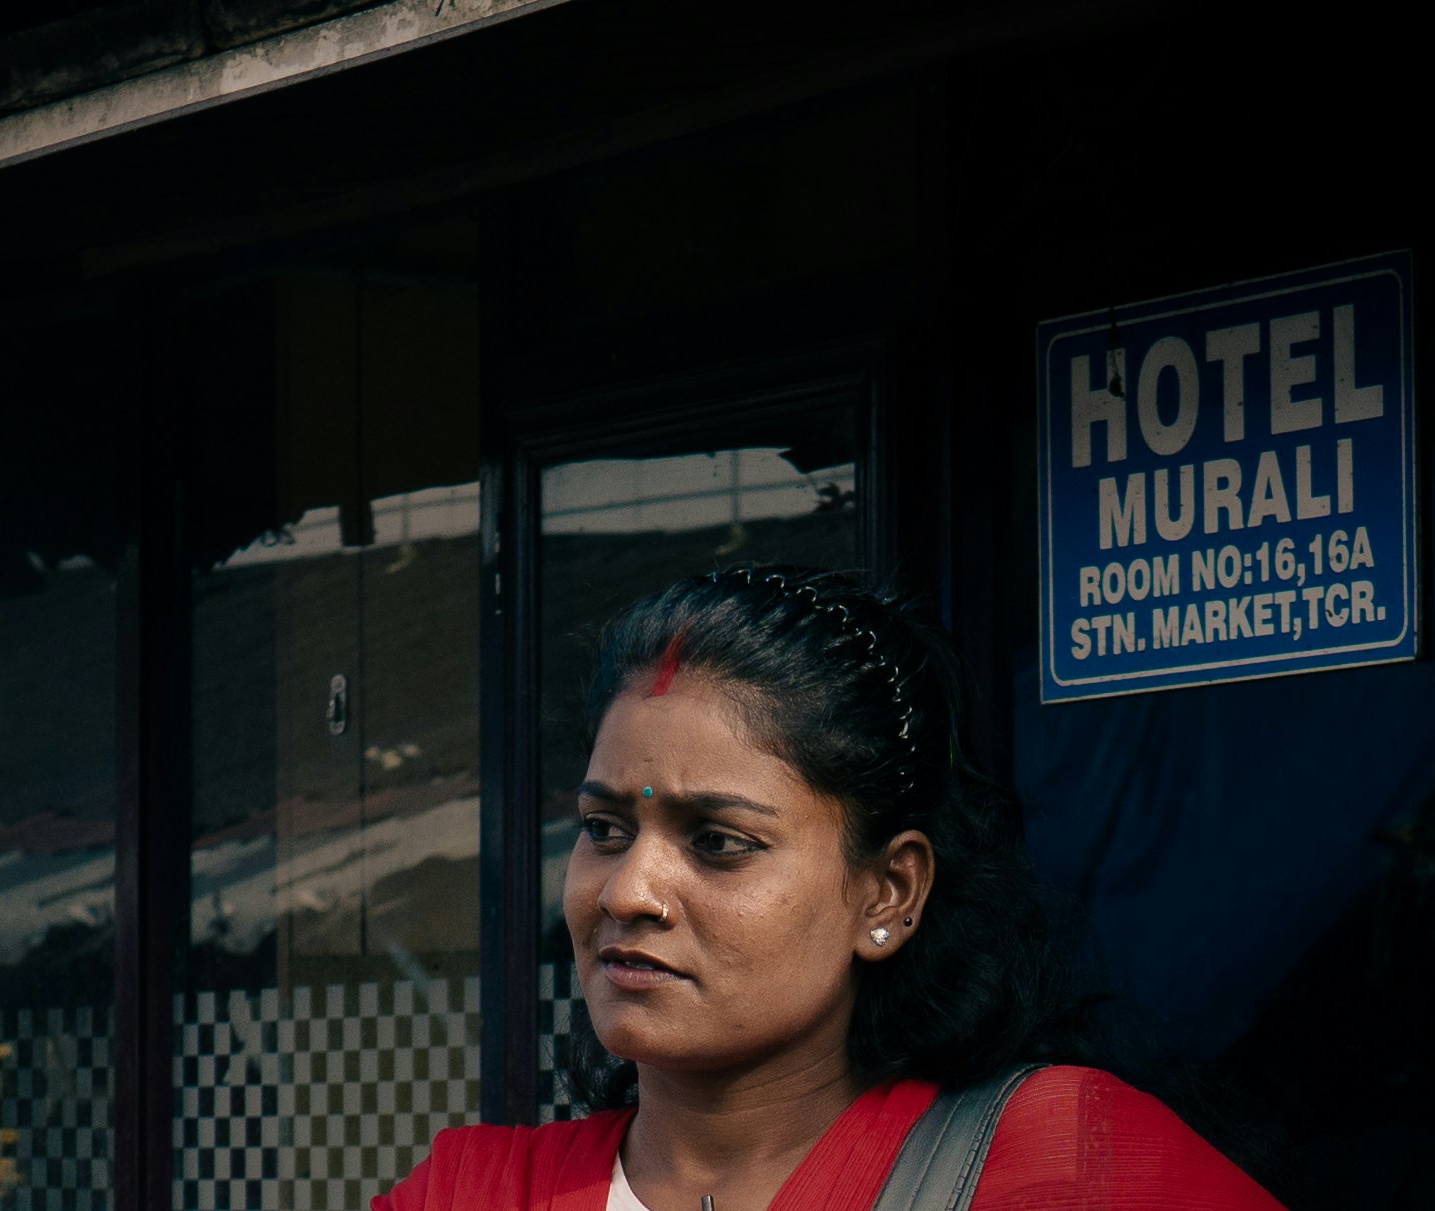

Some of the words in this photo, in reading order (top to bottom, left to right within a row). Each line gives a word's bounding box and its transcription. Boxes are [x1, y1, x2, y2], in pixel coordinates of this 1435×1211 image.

[1071, 304, 1384, 468] HOTEL
[1099, 439, 1354, 549] MURALI
[1080, 554, 1180, 607] ROOM
[1192, 527, 1375, 592] NO:16,16A
[1071, 613, 1146, 660] STN.
[1152, 580, 1386, 649] MARKET,TCR.
